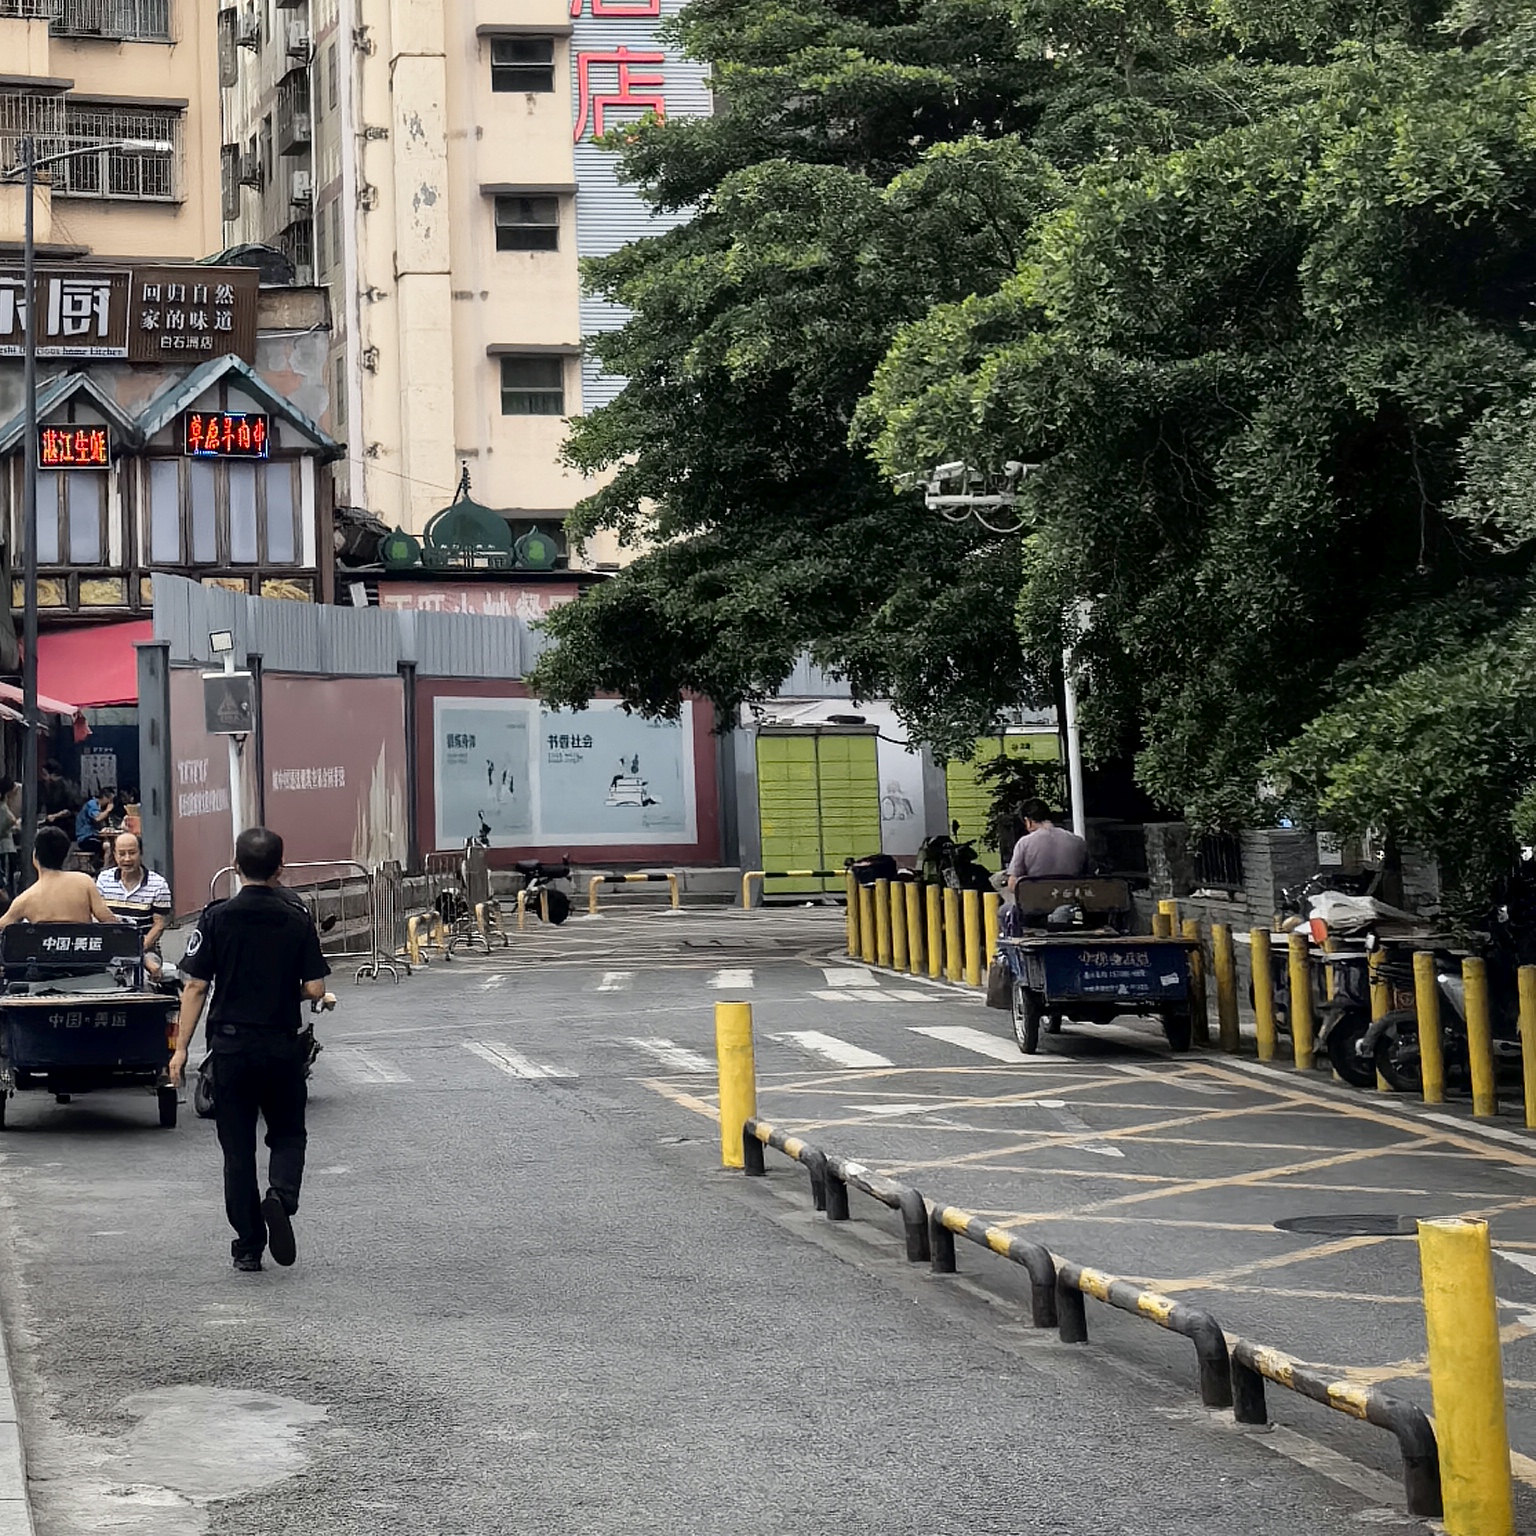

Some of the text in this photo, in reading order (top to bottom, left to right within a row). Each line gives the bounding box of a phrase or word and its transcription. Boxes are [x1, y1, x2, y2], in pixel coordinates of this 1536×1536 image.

[143, 282, 235, 305] 回归自然
[141, 308, 233, 331] 家的味道
[160, 335, 213, 350] 白石洲店
